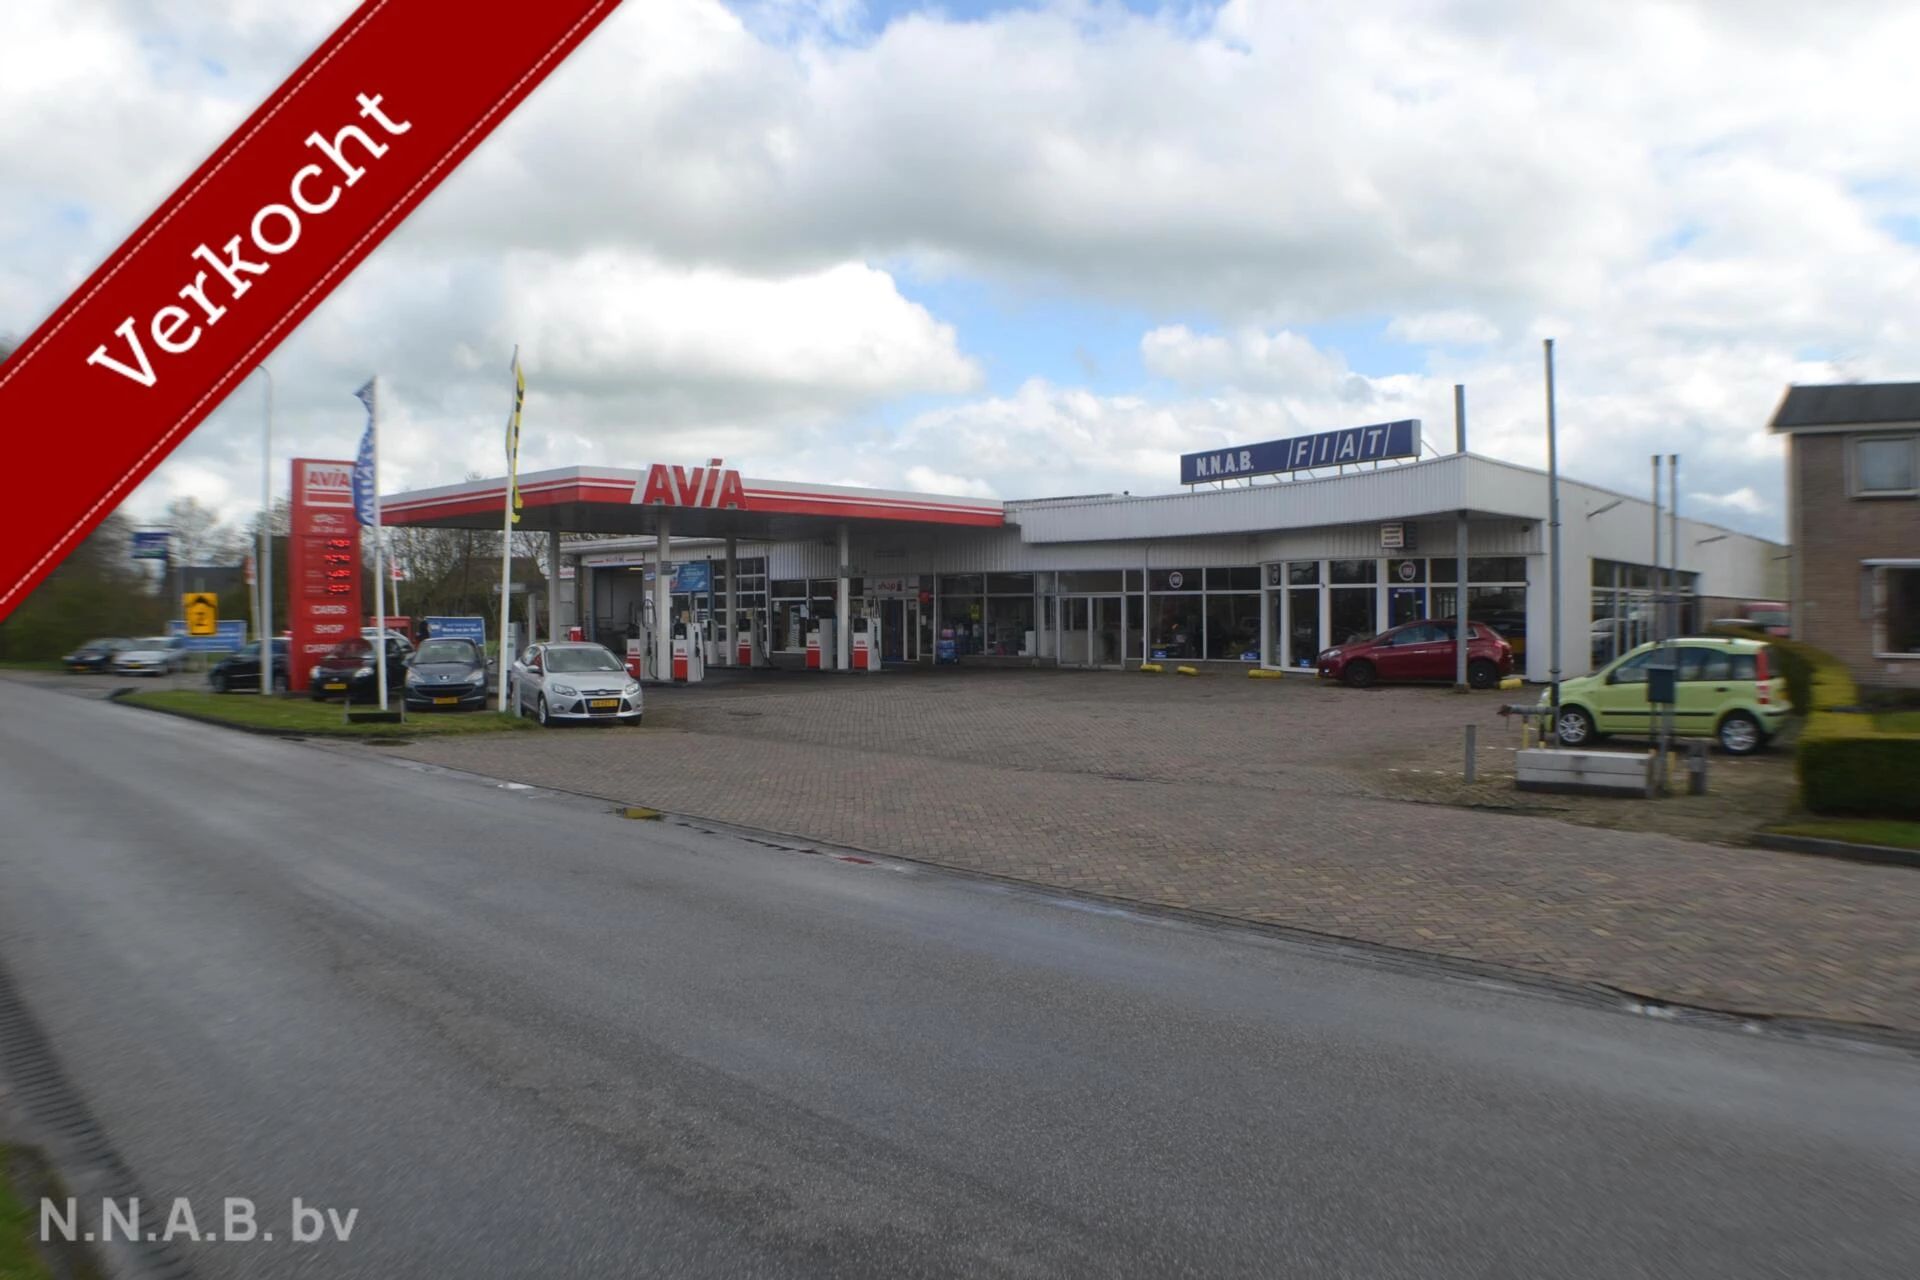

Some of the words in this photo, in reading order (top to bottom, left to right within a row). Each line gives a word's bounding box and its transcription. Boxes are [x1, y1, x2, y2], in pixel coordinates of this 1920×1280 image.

[1196, 450, 1255, 477] N.N.A.B.
[1294, 429, 1383, 465] FIAT
[642, 458, 748, 511] AVIA
[310, 604, 348, 615] CARDS
[313, 623, 345, 634] SHOP
